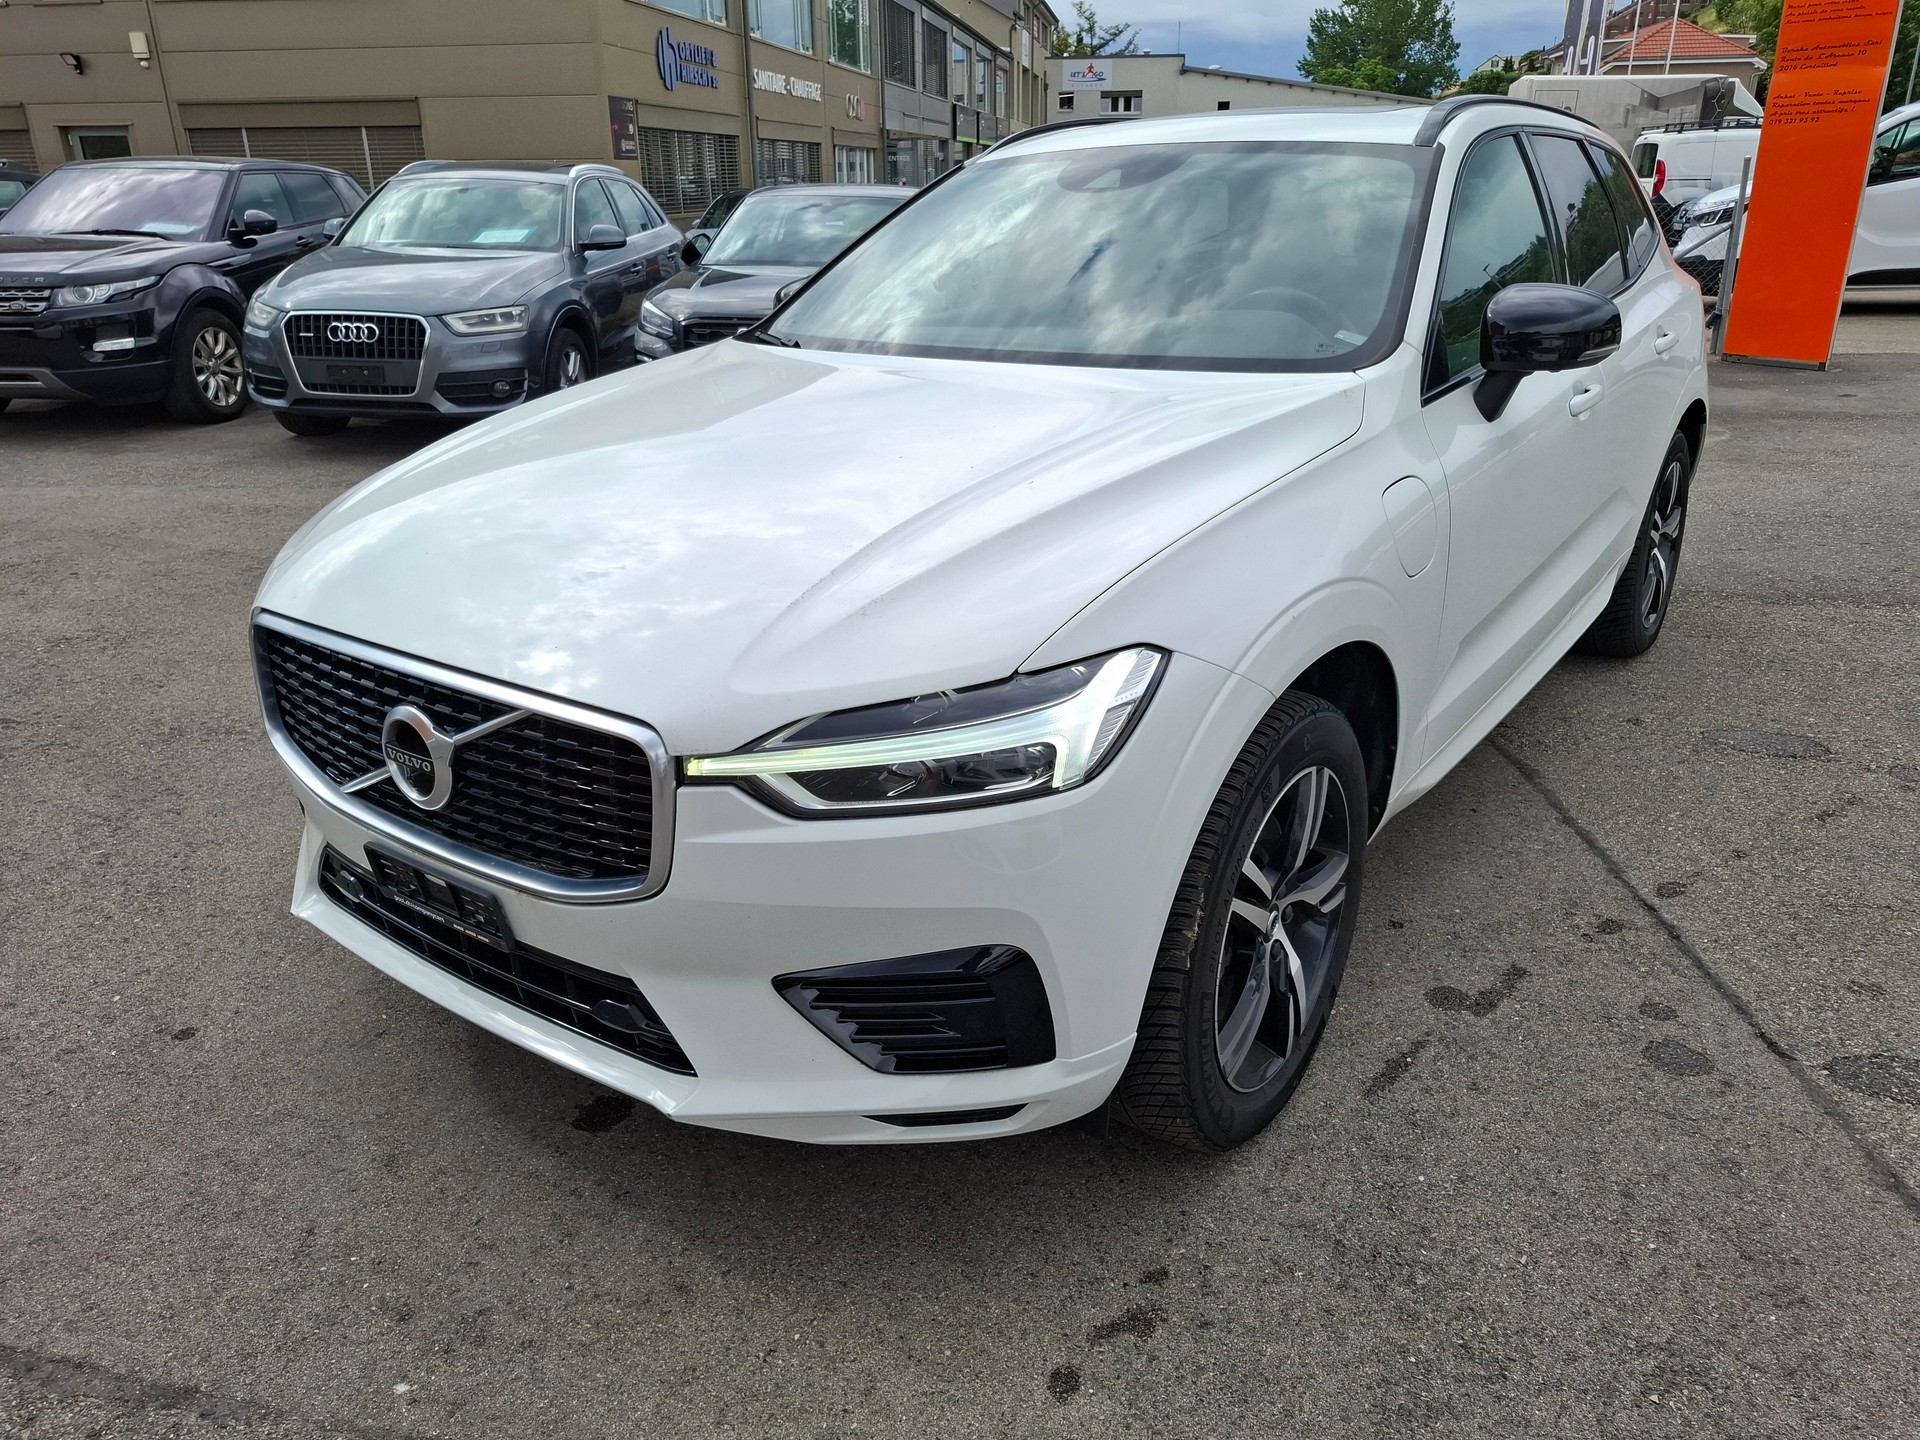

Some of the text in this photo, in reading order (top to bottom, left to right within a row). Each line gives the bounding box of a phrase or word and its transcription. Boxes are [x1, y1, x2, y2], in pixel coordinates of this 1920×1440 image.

[1778, 64, 1798, 72] 2016
[754, 68, 787, 95] SANITAIRE
[789, 77, 822, 102] CHAUFFAGE
[387, 747, 432, 772] VOLVO
